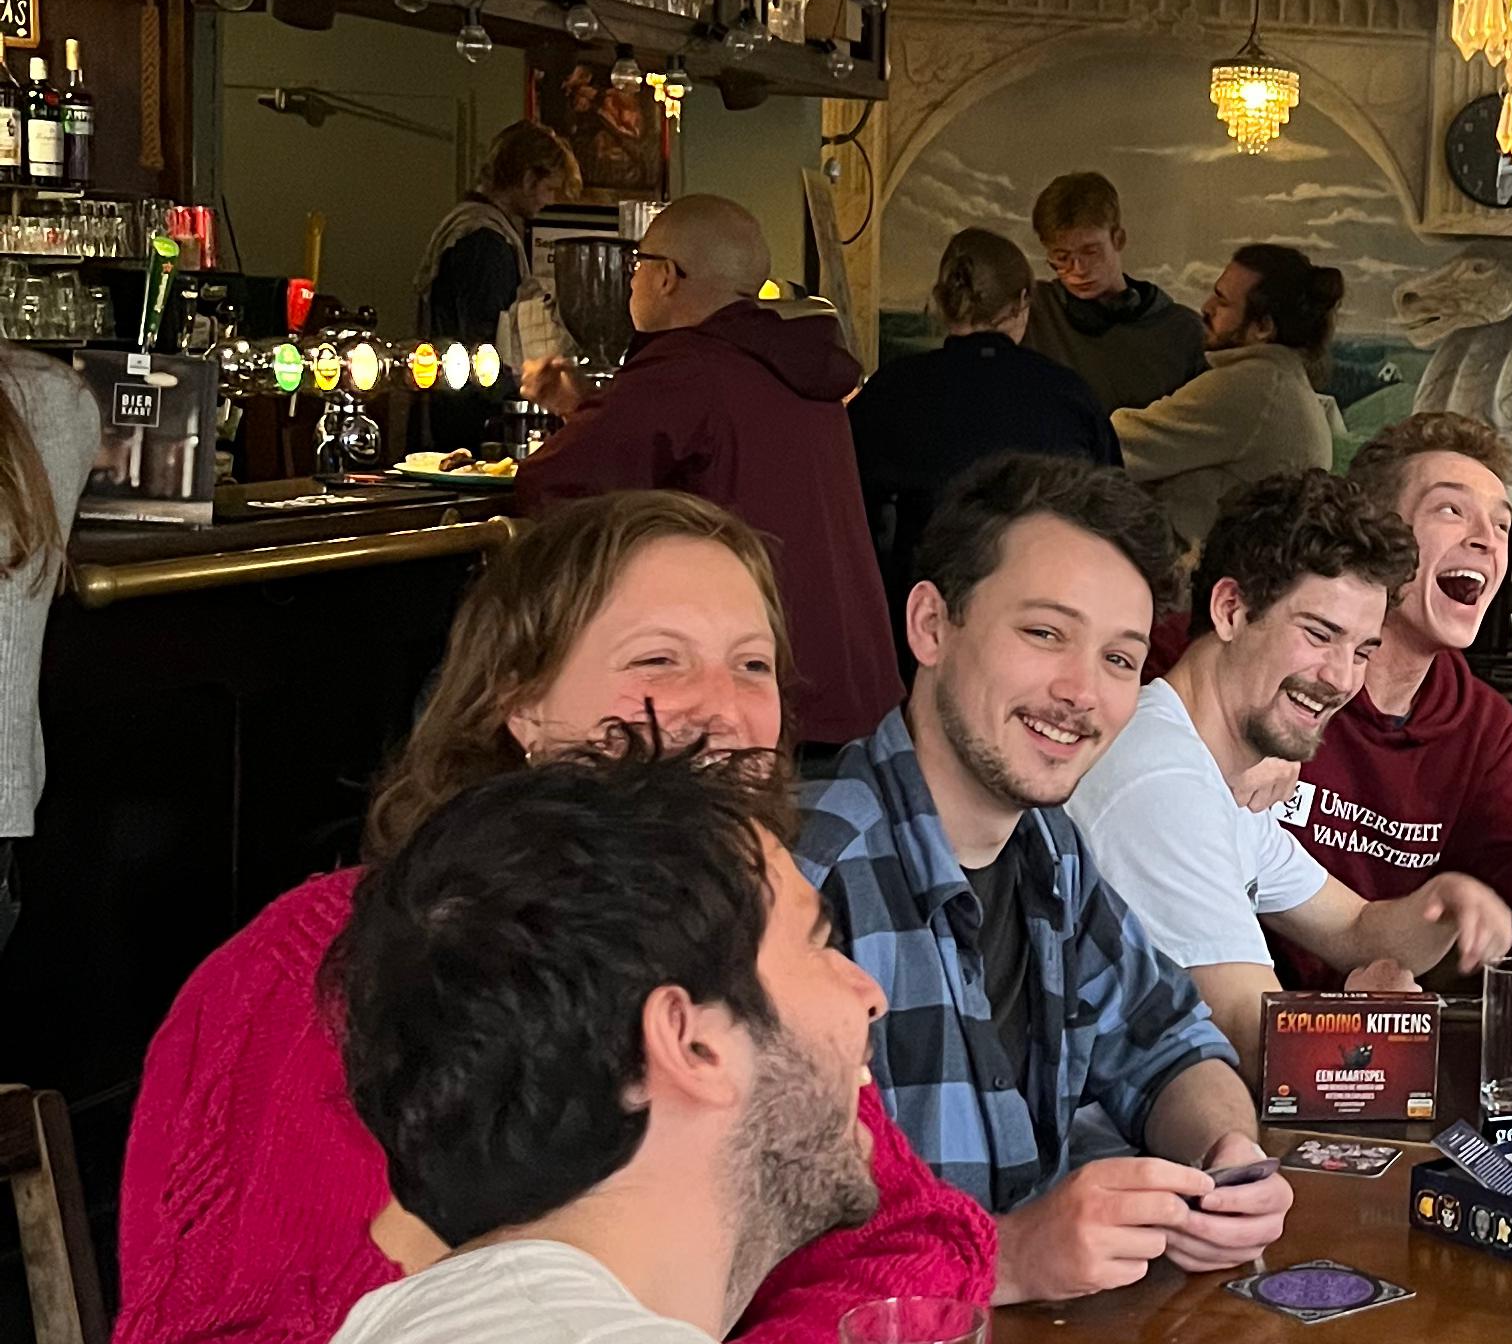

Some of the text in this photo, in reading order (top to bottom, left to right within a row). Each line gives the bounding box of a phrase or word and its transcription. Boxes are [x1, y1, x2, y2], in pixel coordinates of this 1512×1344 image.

[121, 394, 152, 406] BIER
[1347, 829, 1440, 868] AMSTERDA
[1277, 1012, 1432, 1034] EXPLODING KITTENS
